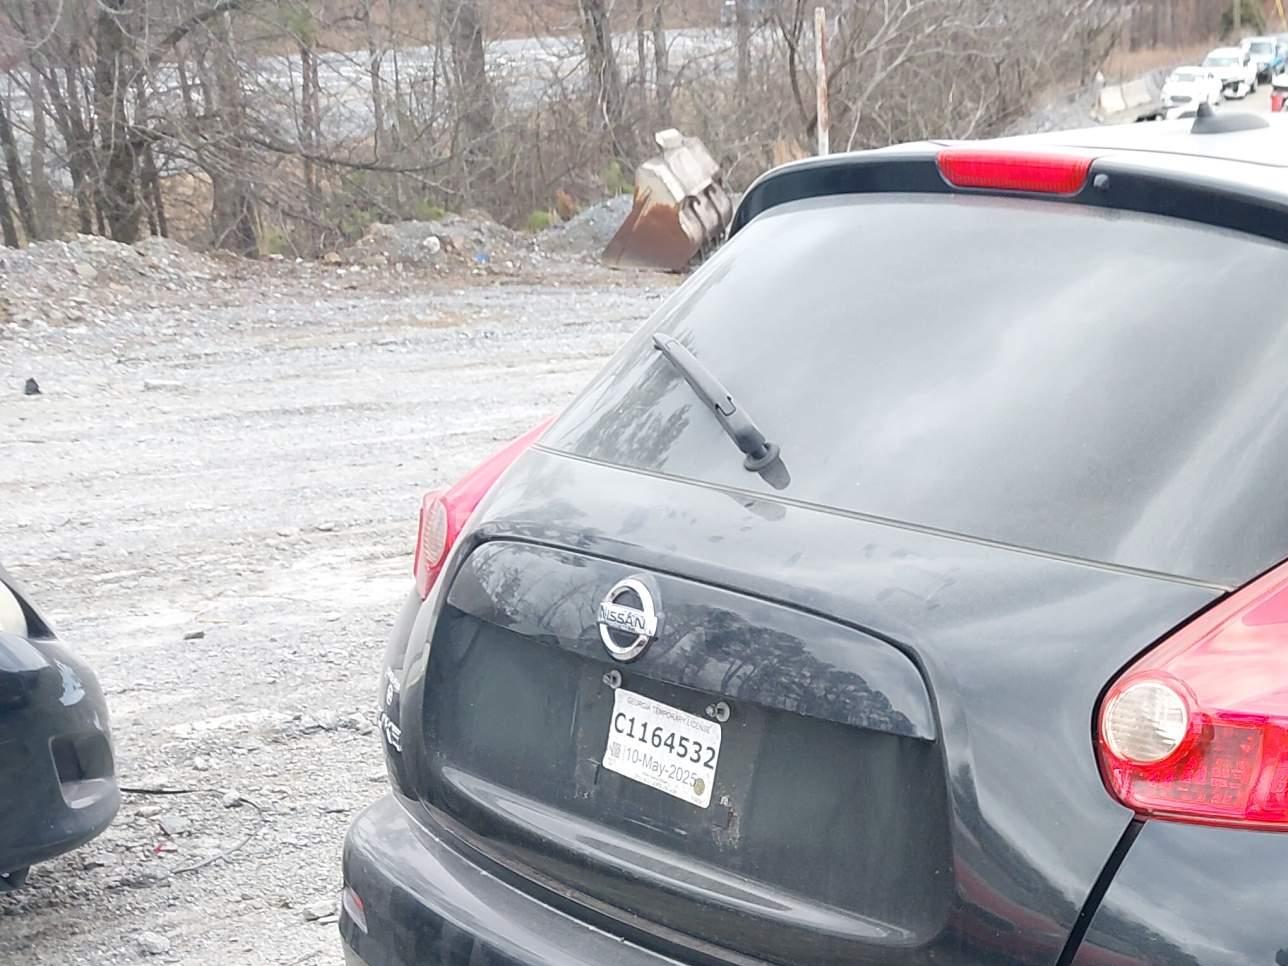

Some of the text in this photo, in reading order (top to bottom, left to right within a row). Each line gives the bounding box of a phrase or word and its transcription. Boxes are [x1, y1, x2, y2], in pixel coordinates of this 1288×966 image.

[600, 603, 645, 630] NISSAN
[614, 712, 716, 770] C1164532
[626, 747, 698, 788] 10-May-2025
